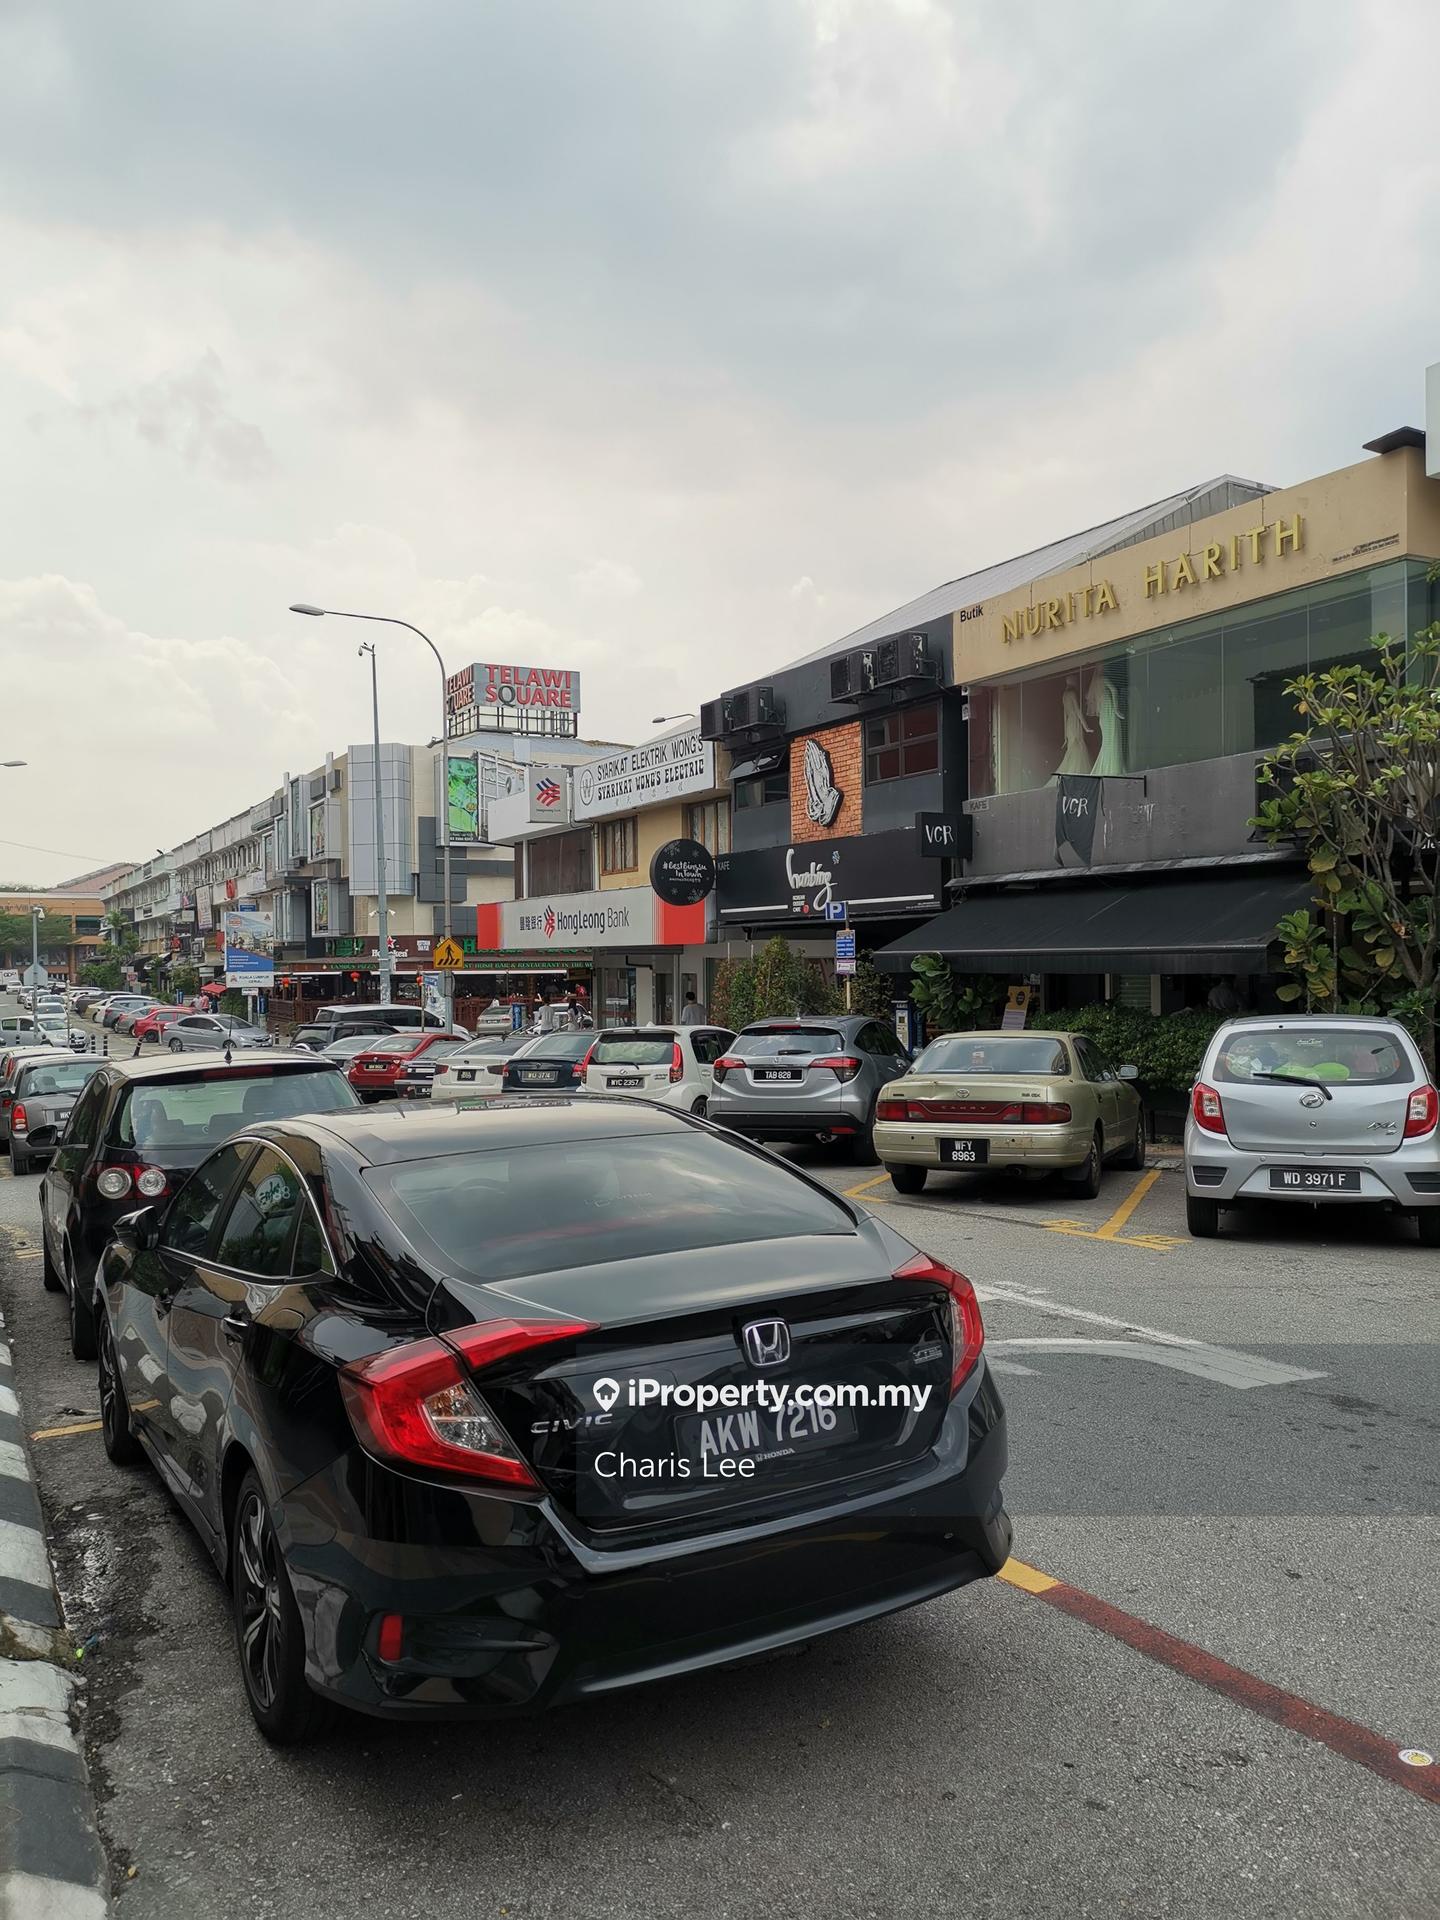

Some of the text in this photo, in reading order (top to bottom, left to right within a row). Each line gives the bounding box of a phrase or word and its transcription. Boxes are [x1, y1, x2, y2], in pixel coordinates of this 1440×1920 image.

[1001, 513, 1303, 644] NURITA HARITH
[960, 605, 983, 622] Butik
[447, 665, 473, 695] ELAWI
[485, 664, 571, 688] TELAWI
[485, 683, 571, 708] SQUARE
[597, 734, 703, 781] SYARIKAT ELEKTRIK WONG'S
[598, 779, 632, 801] SYARIKAT
[635, 770, 661, 791] WONG'S
[664, 758, 704, 783] ELECTRIC
[1062, 796, 1089, 817] VCR
[925, 824, 954, 845] VCR
[557, 906, 629, 935] HongLeong Bank
[830, 903, 842, 919] P
[765, 1071, 791, 1079] TAB 828
[952, 1151, 976, 1162] 8963
[954, 1141, 972, 1151] WFY
[1283, 1172, 1346, 1185] WD 3971 F
[530, 1413, 613, 1434] CIVIC
[700, 1394, 837, 1458] AKW 7216
[764, 1447, 795, 1460] HONDA
